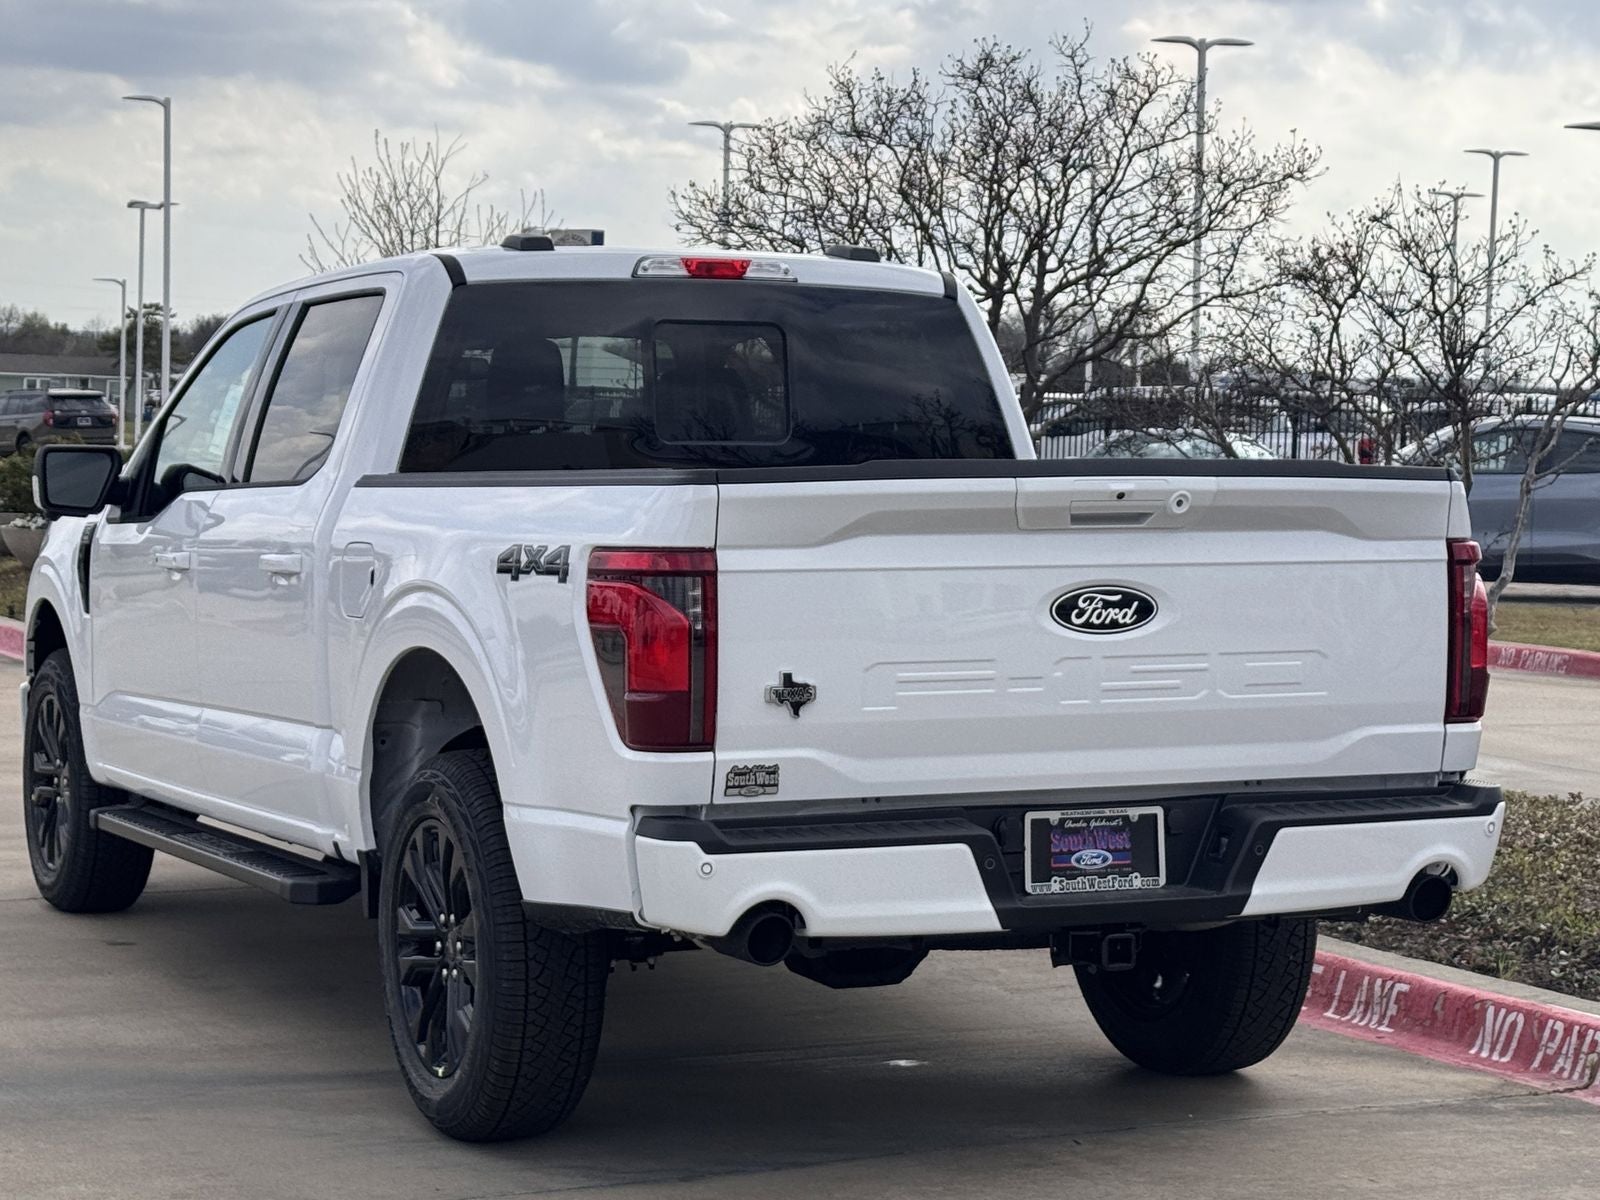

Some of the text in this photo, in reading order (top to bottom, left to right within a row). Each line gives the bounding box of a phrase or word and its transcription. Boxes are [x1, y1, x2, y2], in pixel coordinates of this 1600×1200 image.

[1071, 593, 1139, 625] Ford
[1498, 647, 1569, 673] NO PARKING
[771, 687, 815, 702] TEXAS
[1080, 852, 1103, 865] Ford
[1323, 970, 1410, 1032] LANE
[1469, 1005, 1525, 1062] NO
